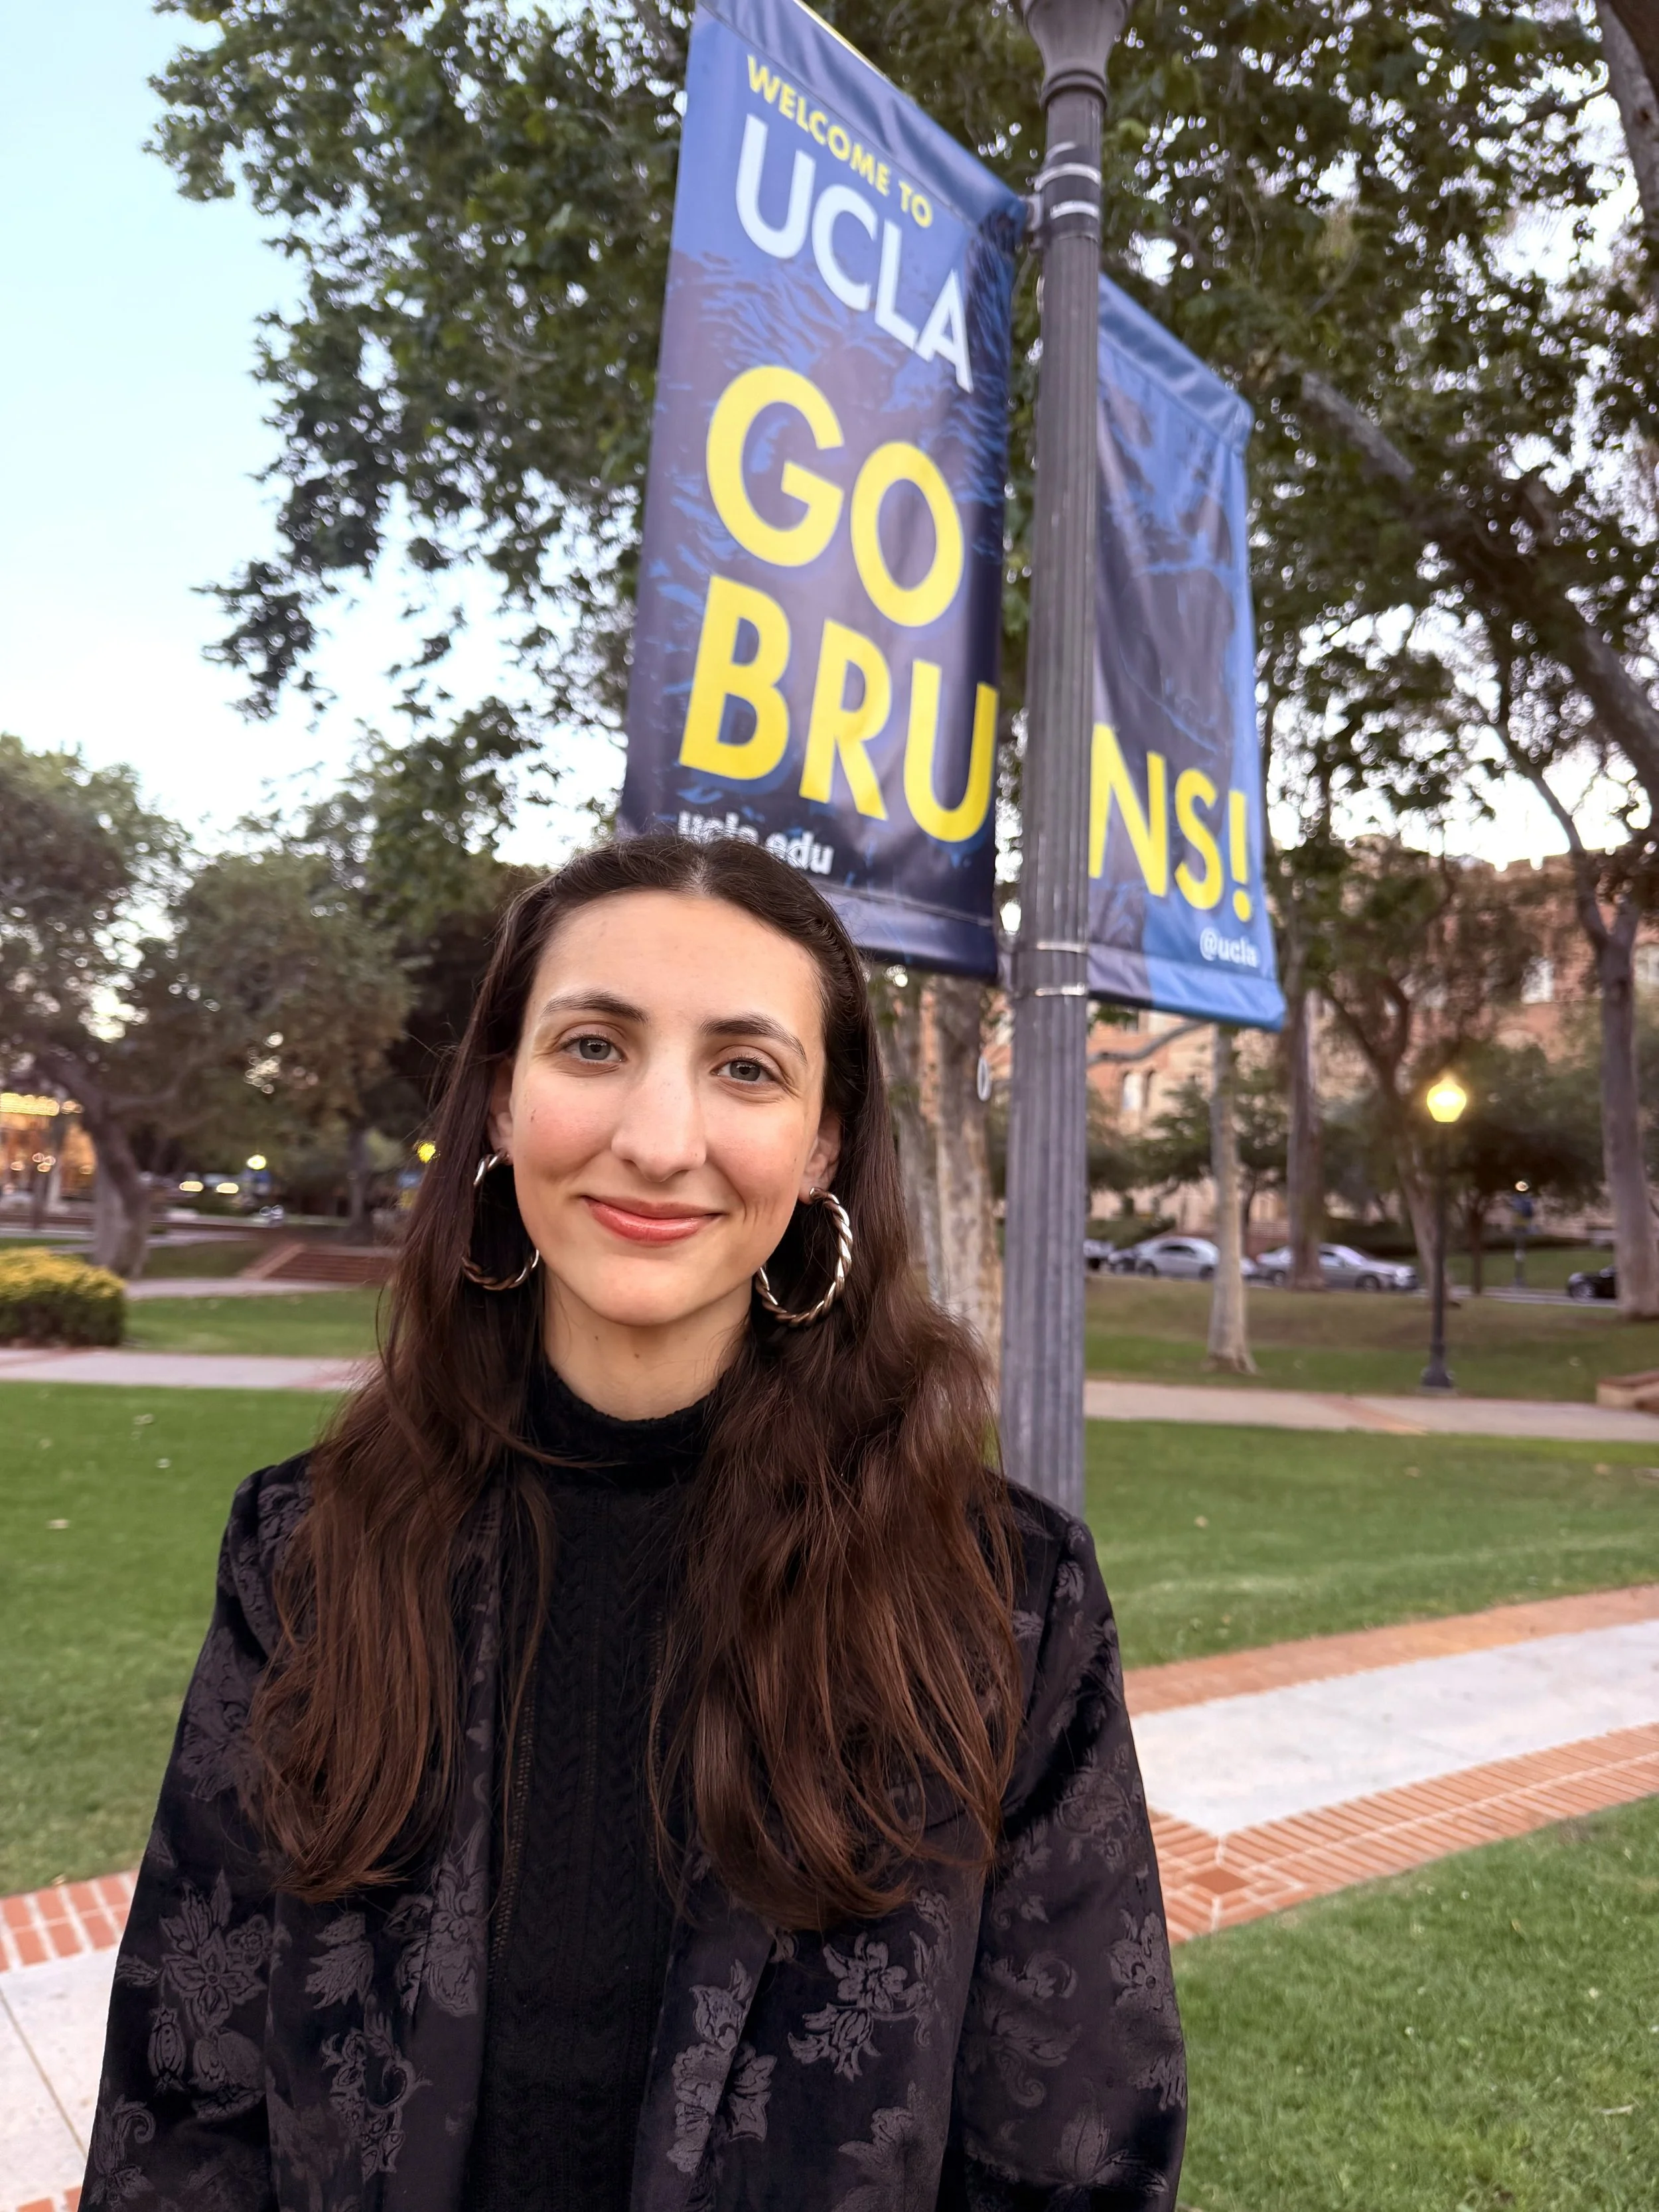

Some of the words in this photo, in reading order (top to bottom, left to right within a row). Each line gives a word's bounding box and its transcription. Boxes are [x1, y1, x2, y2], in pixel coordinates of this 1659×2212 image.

[735, 113, 974, 394] UCLA
[747, 54, 891, 197] WELCOME
[899, 181, 933, 228] TO
[706, 364, 964, 627] GO
[679, 573, 999, 843] BRU
[1088, 722, 1252, 922] NS!
[1199, 926, 1259, 968] @ucla
